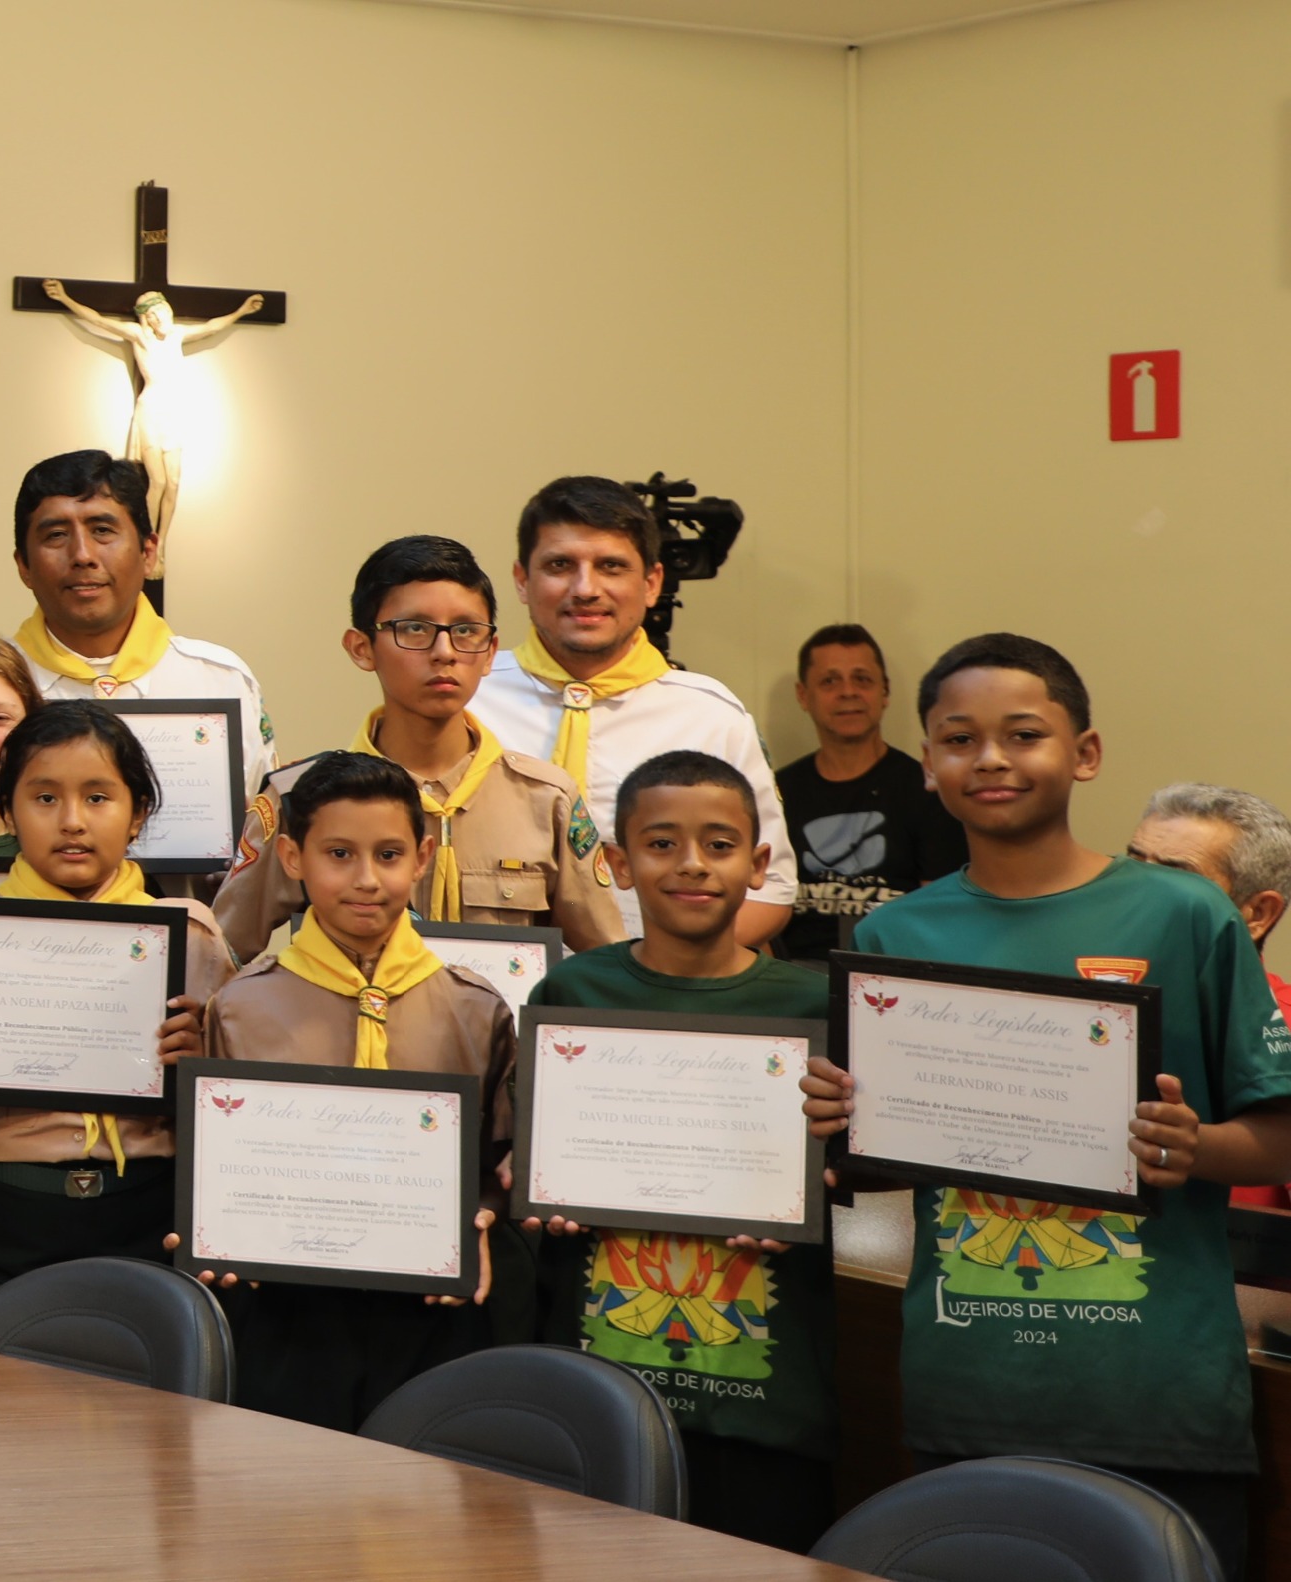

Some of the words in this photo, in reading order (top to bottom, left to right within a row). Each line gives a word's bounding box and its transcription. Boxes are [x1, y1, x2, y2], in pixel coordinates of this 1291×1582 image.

[178, 779, 210, 787] CALLA
[31, 936, 115, 961] Legislativo
[10, 997, 50, 1008] NOEMI
[53, 1000, 91, 1012] APAZA
[94, 1001, 128, 1014] MEJÍA
[905, 1000, 962, 1025] Poder
[967, 1008, 1073, 1038] Legislativo
[592, 1046, 646, 1066] Poder
[650, 1050, 750, 1074] Legislativo
[915, 1071, 1003, 1093] ALERRANDRO
[1007, 1084, 1026, 1096] DE
[1029, 1087, 1068, 1101] ASSIS
[251, 1100, 304, 1120] Poder
[310, 1104, 405, 1129] Legislativo
[887, 1095, 930, 1108] Certificado
[944, 1103, 1008, 1119] Reconhecimento
[579, 1111, 618, 1123] DAVID
[622, 1114, 672, 1126] MIGUEL
[676, 1117, 727, 1129] SOARES
[731, 1121, 768, 1132] SILVA
[219, 1164, 260, 1176] DIEGO
[264, 1167, 320, 1180] VINICIUS
[324, 1171, 370, 1184] GOMES
[374, 1174, 391, 1185] DE
[394, 1175, 443, 1188] ARAUJO
[934, 1276, 1023, 1327] LUZEIROS
[1029, 1304, 1057, 1319] DE
[1063, 1304, 1141, 1323] VIÇOSA
[1013, 1330, 1058, 1344] 2024
[676, 1374, 698, 1389] DE
[702, 1378, 765, 1399] VIÇOSA
[665, 1397, 696, 1411] 024
